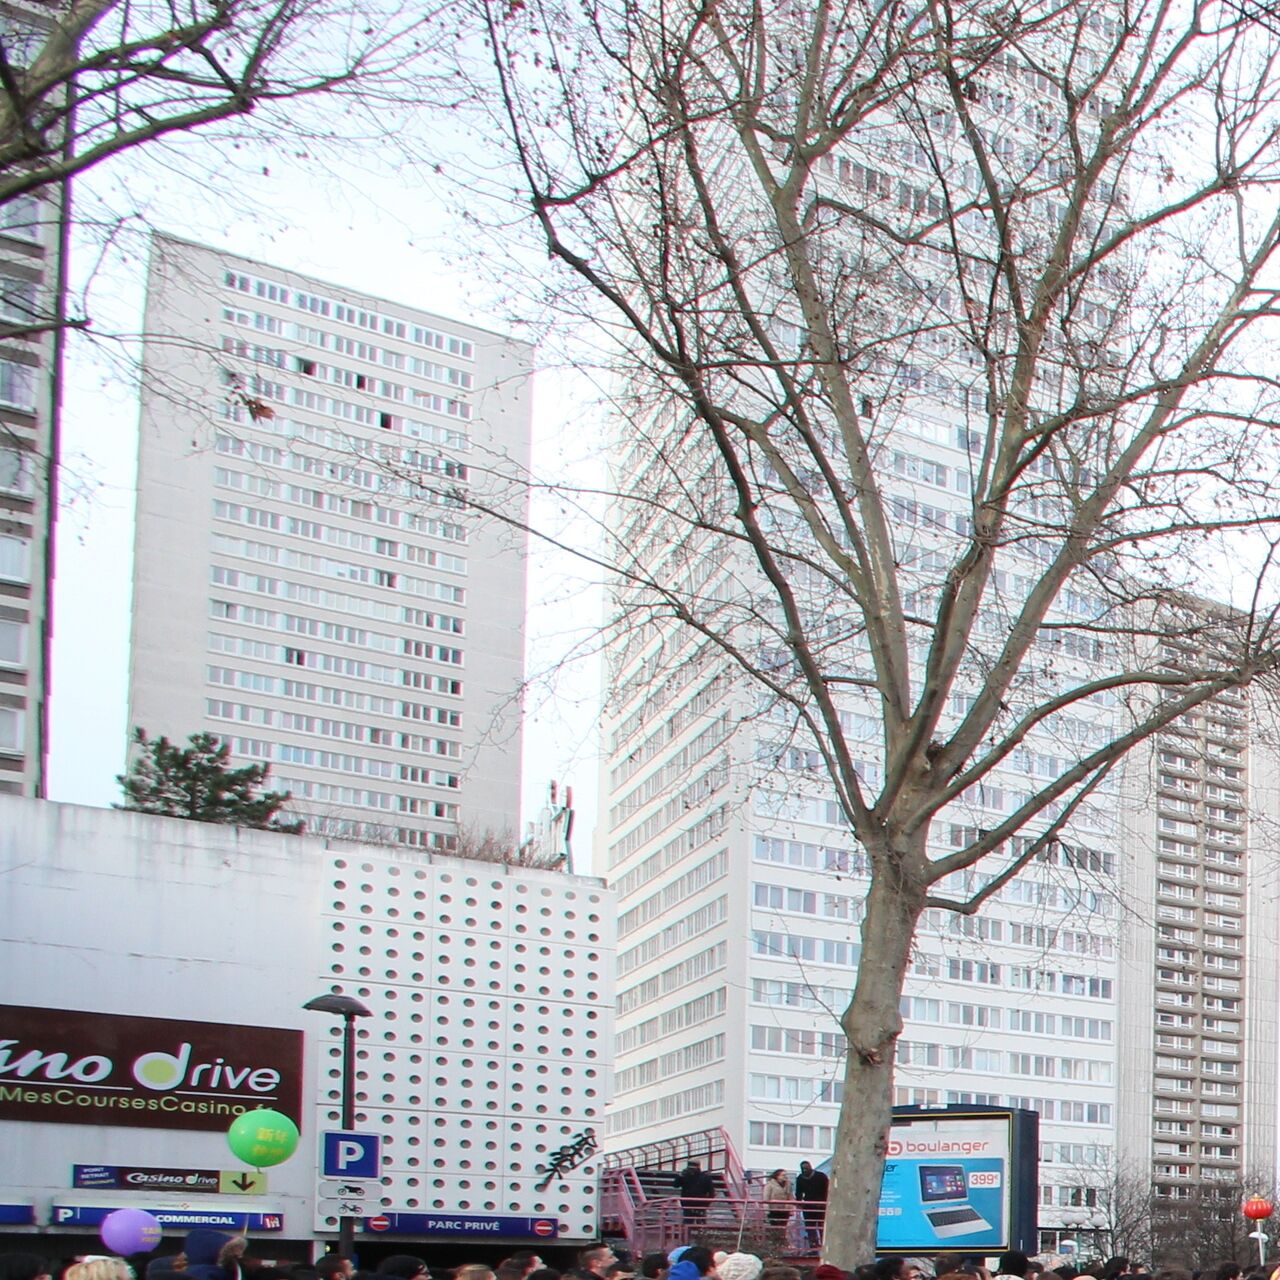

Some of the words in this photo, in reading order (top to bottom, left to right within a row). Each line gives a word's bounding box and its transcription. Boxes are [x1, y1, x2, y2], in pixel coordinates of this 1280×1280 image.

[134, 1043, 281, 1092] drive
[0, 1086, 274, 1116] MesCoursesCasinof
[337, 1141, 365, 1169] P
[906, 1140, 989, 1155] boulanger
[126, 1172, 184, 1184] Casino
[185, 1173, 218, 1185] drive
[58, 1208, 74, 1222] P
[157, 1214, 235, 1225] COMMERCIAL
[428, 1220, 461, 1230] PARC
[464, 1220, 501, 1231] PRIVÉ
